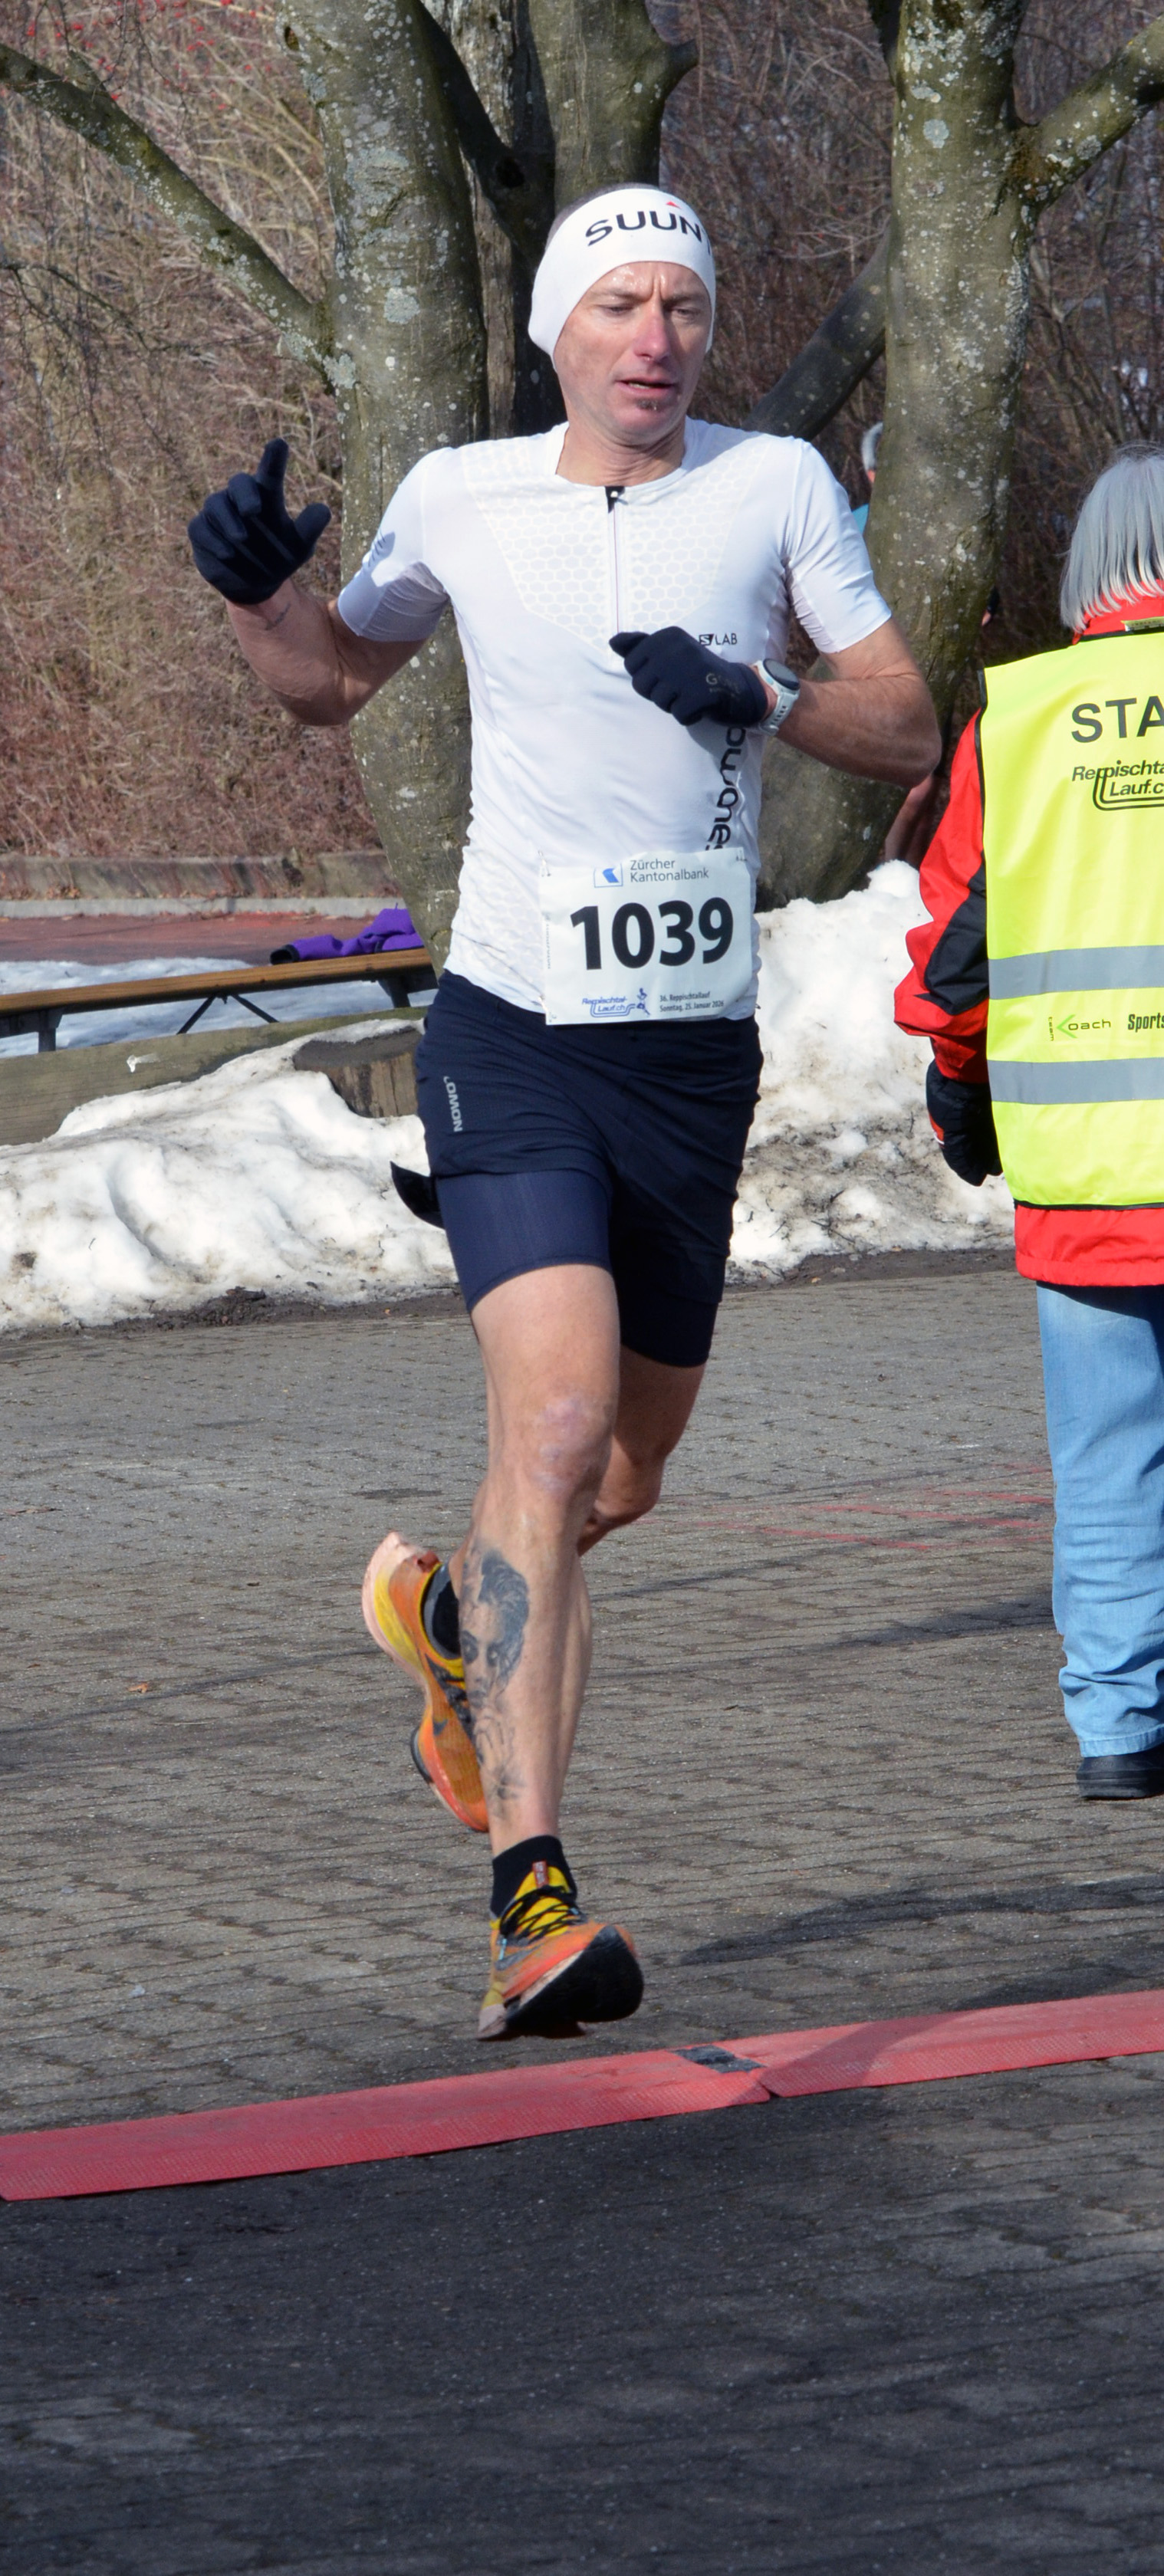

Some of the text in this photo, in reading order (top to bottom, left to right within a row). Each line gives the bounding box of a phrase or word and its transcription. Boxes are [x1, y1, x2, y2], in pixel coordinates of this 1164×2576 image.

[1071, 695, 1164, 744] STA
[630, 858, 676, 871] Zürcher
[630, 867, 709, 882] Kantonalbank
[570, 897, 734, 970] 1039
